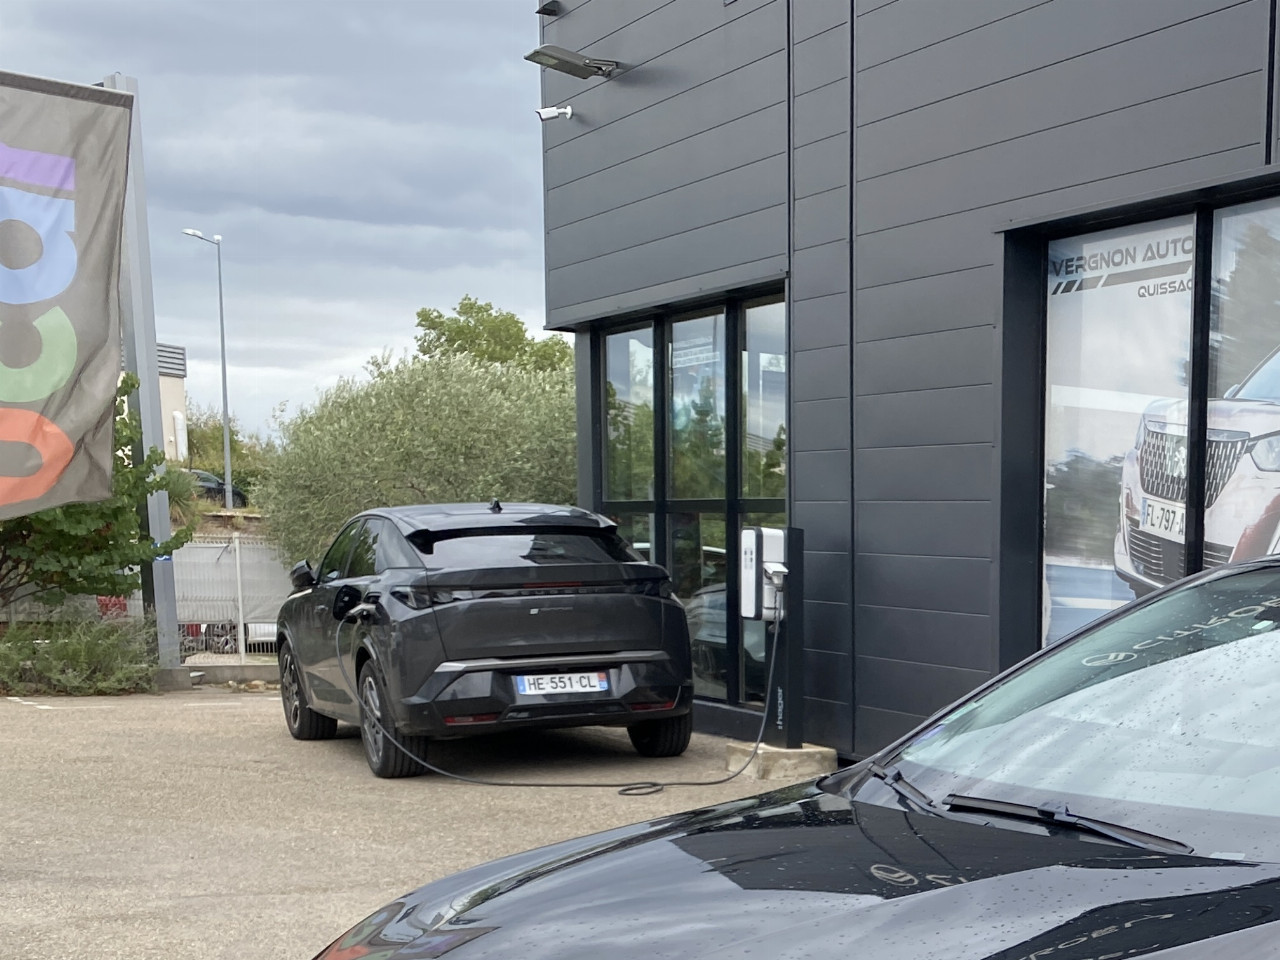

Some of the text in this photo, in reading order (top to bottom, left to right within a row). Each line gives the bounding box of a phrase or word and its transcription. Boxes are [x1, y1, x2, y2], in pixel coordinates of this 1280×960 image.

[1051, 235, 1194, 277] VERGNON AUTO
[527, 675, 597, 691] HE-551-CL
